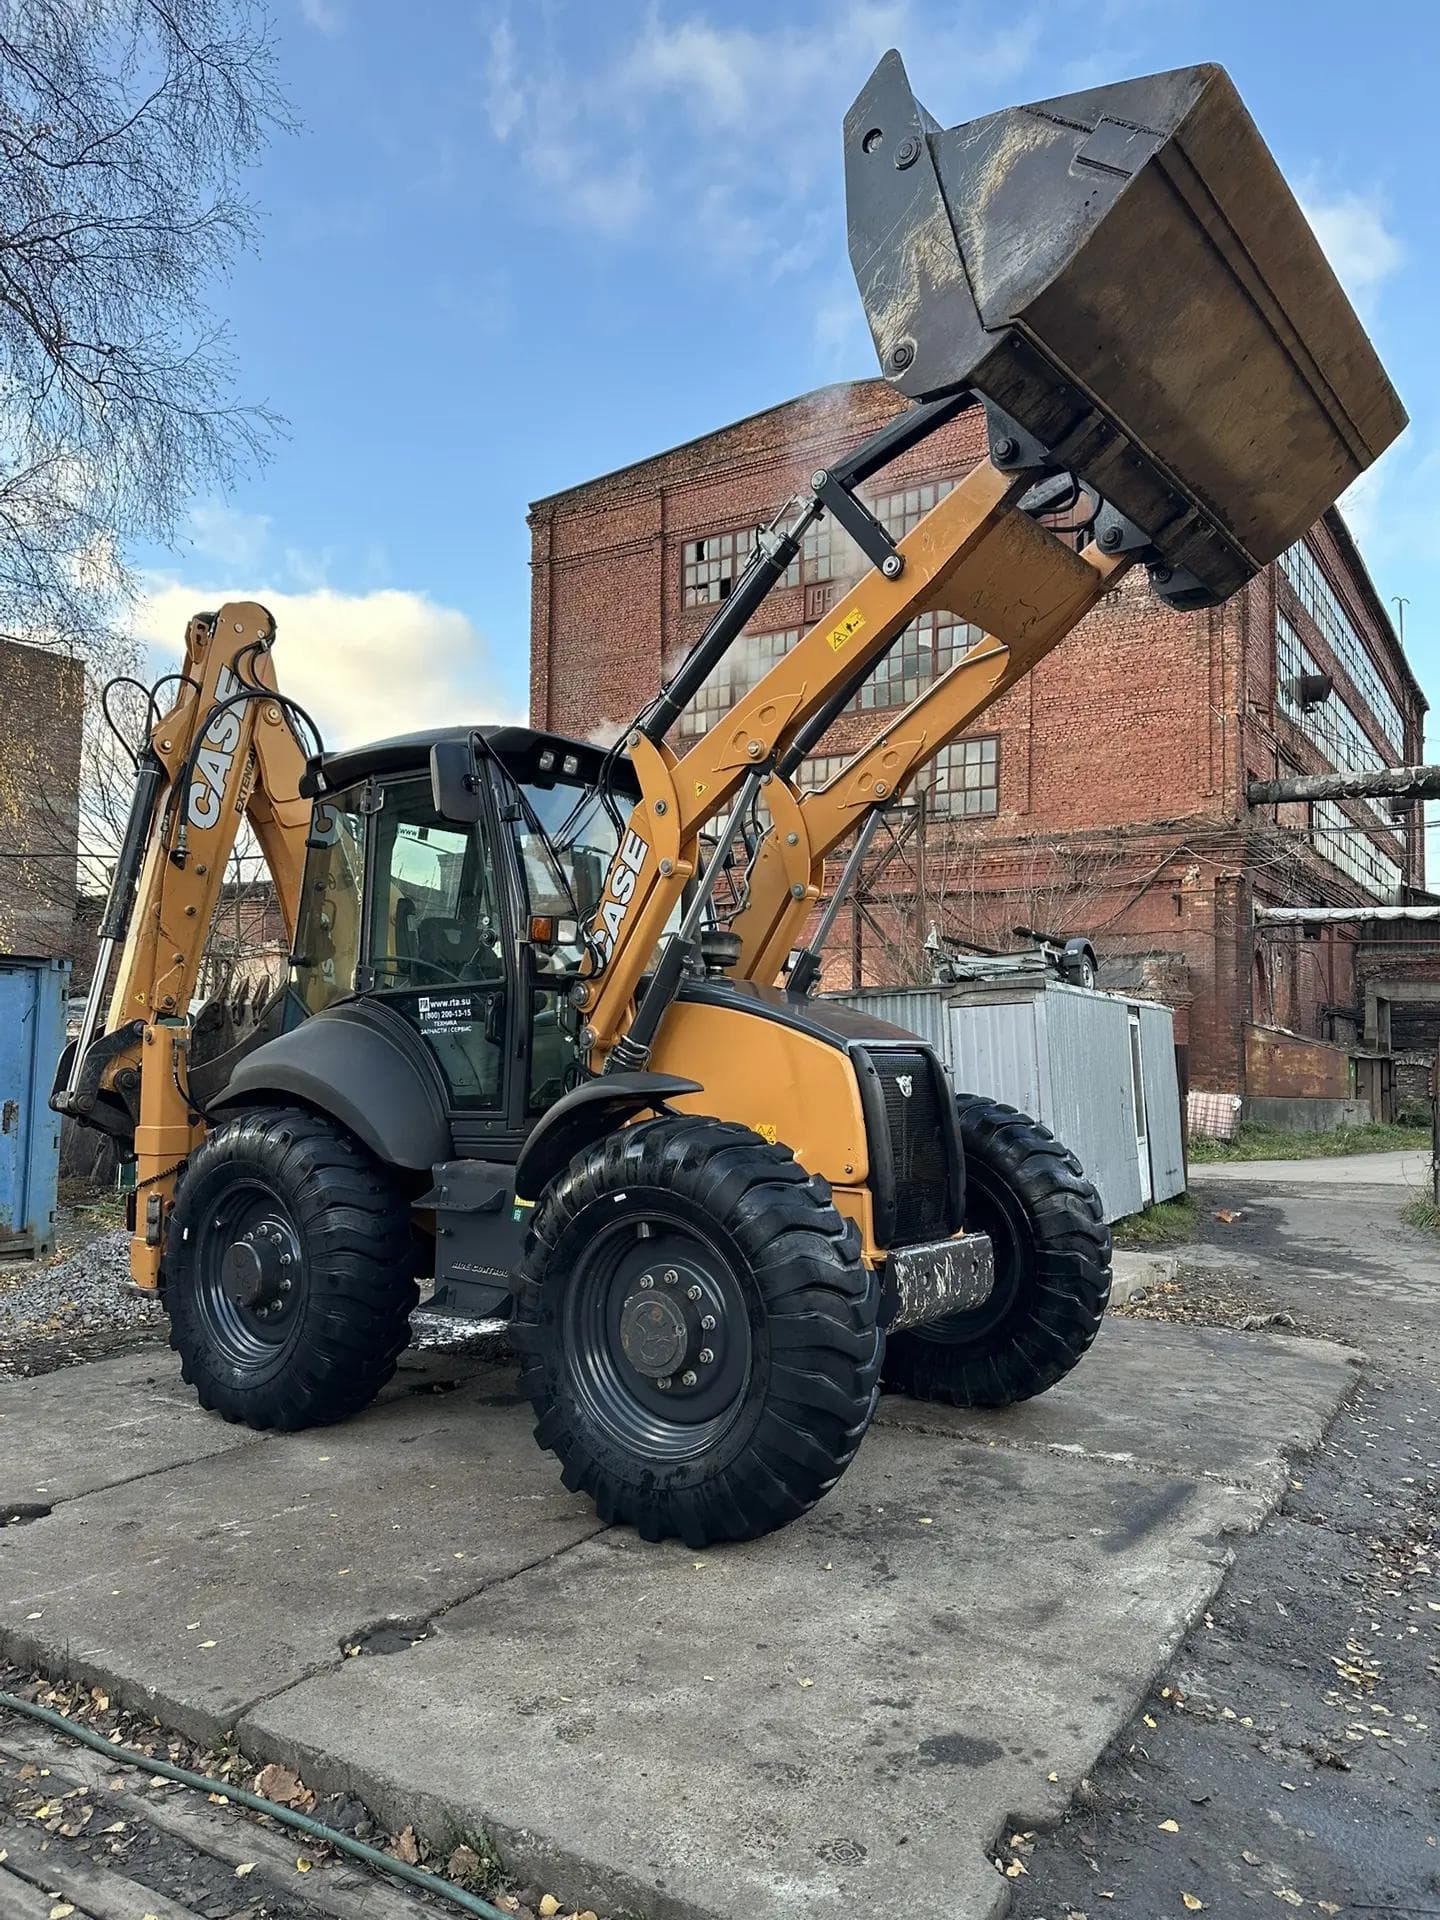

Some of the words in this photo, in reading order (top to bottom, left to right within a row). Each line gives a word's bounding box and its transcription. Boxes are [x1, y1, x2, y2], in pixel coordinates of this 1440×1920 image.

[187, 662, 251, 830] CASE
[430, 999, 471, 1008] www.rta.su
[441, 1009, 471, 1018] 200-13-15
